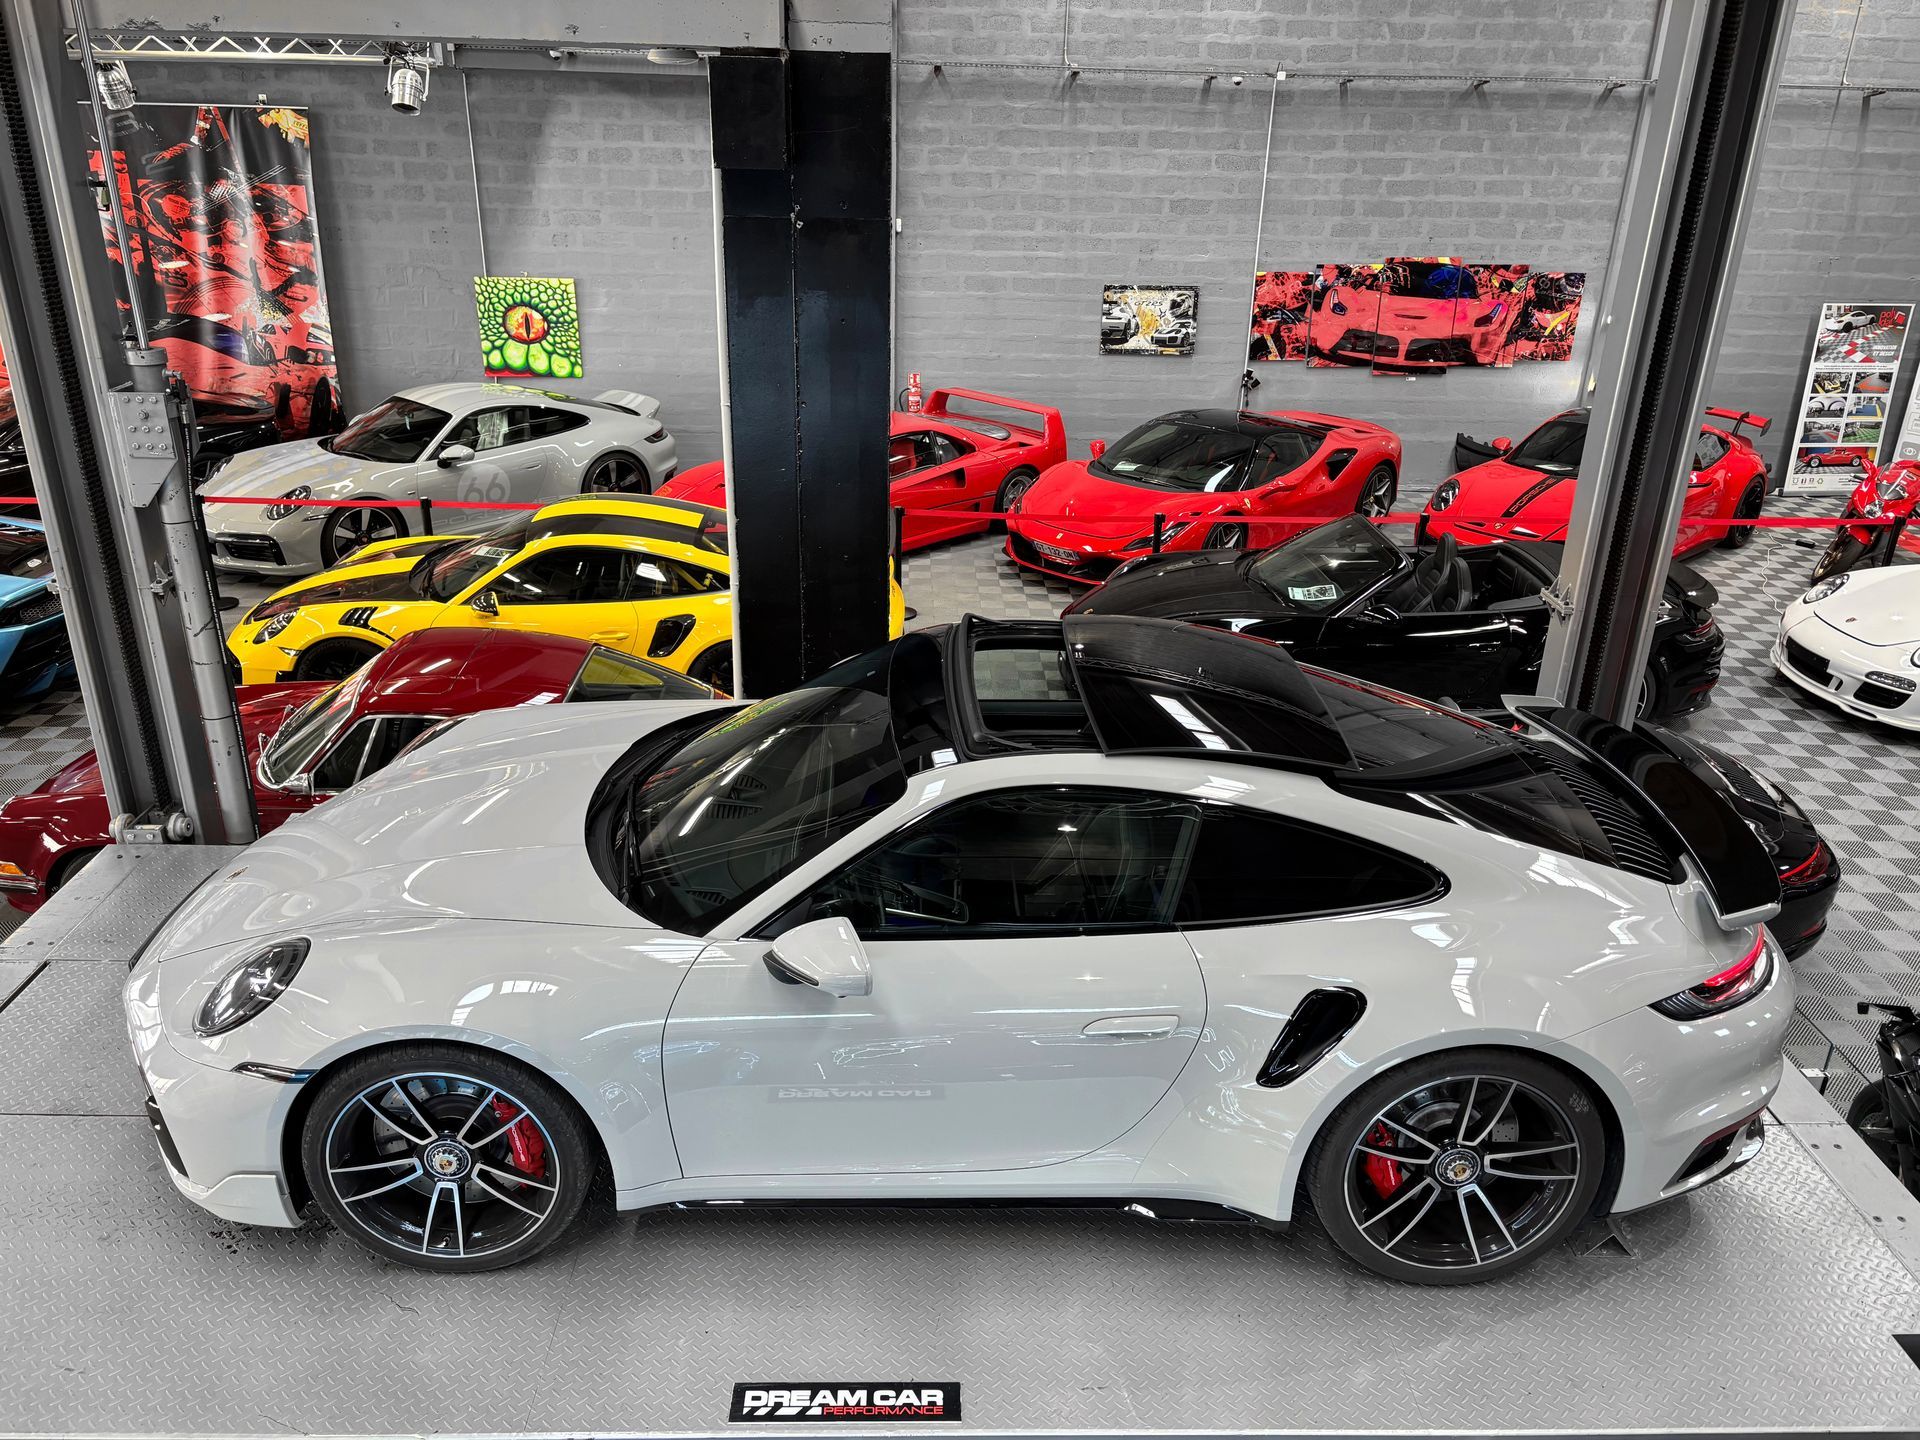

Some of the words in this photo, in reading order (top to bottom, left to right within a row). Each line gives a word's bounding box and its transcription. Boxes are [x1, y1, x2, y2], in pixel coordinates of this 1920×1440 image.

[464, 472, 506, 504] 66
[1508, 477, 1558, 513] PORSCHE
[744, 1389, 867, 1407] DREAM
[873, 1389, 944, 1407] CAR
[823, 1406, 944, 1416] PERFORMANCE
